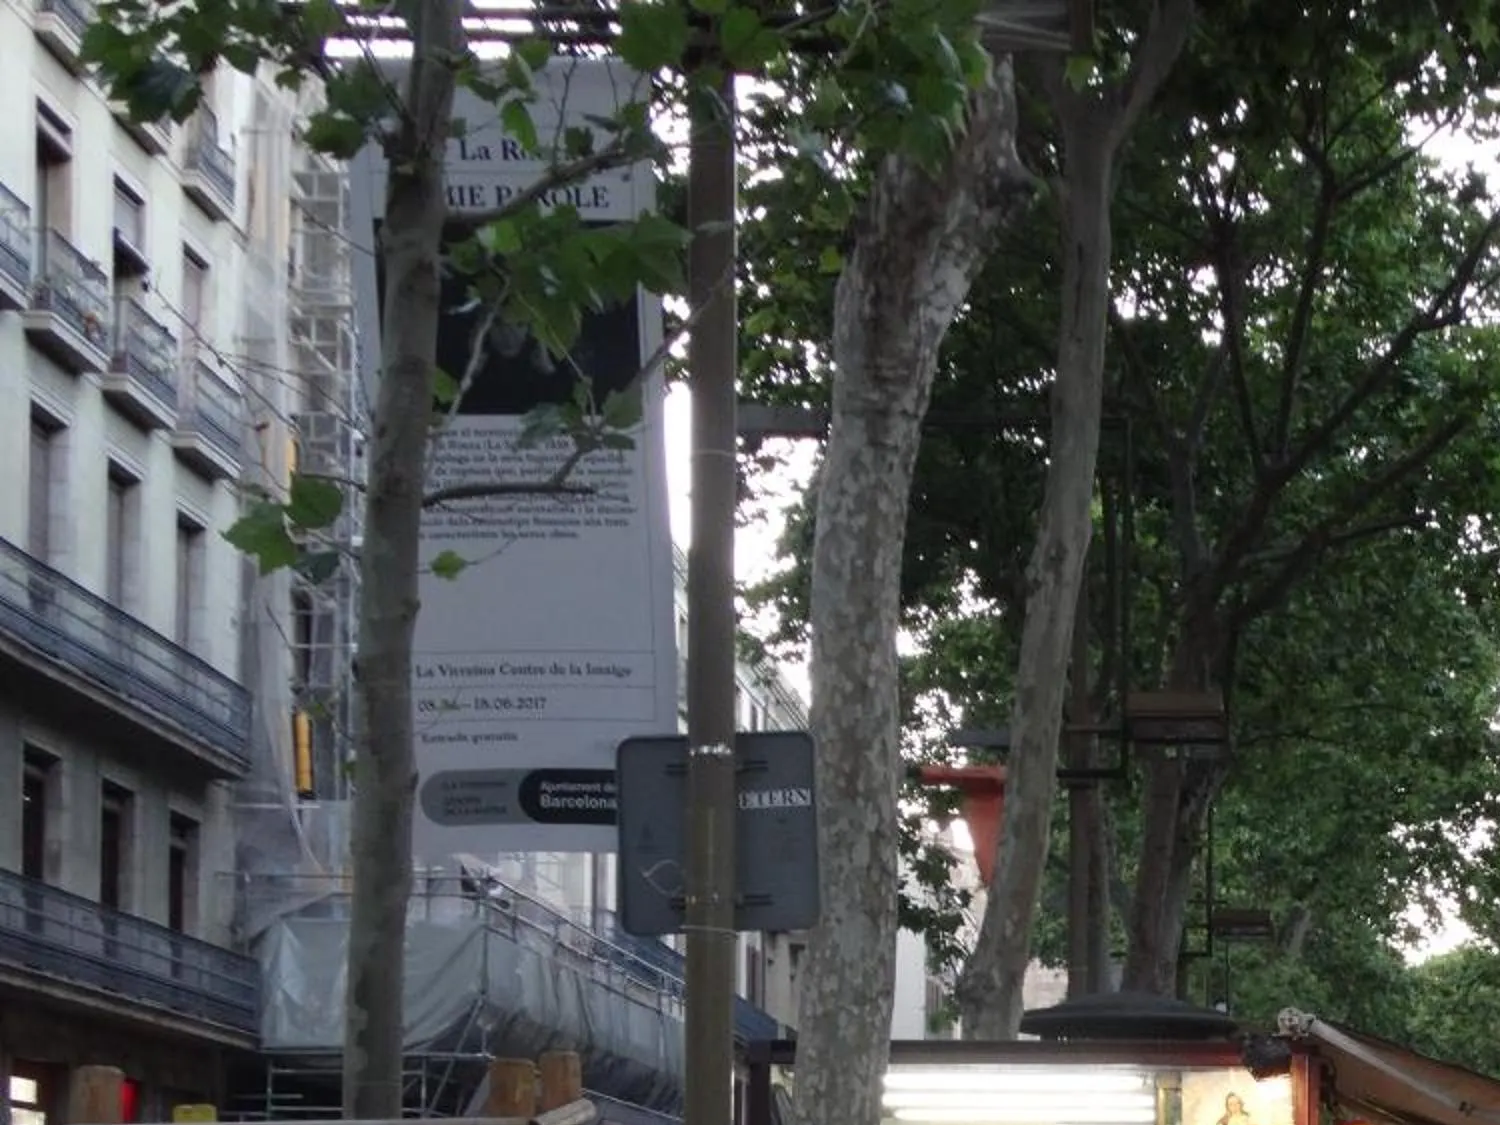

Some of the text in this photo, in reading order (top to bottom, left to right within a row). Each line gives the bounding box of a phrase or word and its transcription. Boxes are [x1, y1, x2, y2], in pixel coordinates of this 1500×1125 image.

[459, 138, 492, 161] La
[415, 664, 435, 678] La
[499, 662, 547, 676] Centre
[549, 661, 567, 676] de
[569, 662, 583, 676] la
[540, 780, 602, 793] Ajuntament
